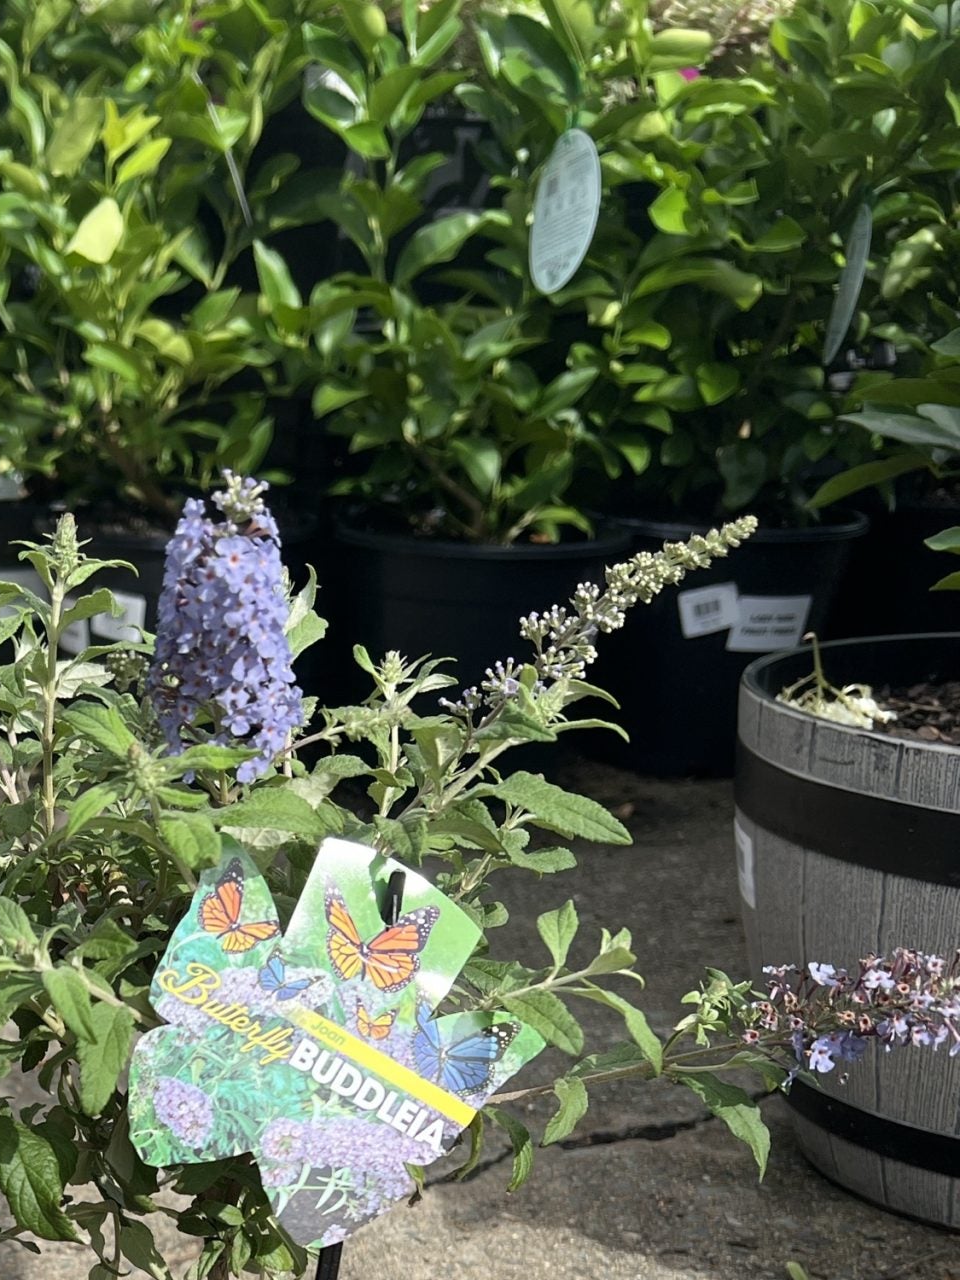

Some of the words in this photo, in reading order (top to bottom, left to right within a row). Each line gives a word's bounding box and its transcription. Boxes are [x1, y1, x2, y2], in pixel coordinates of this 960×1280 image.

[157, 962, 295, 1065] Butterfly
[288, 1039, 443, 1152] BUDDLEIA
[311, 1021, 346, 1045] Joan
